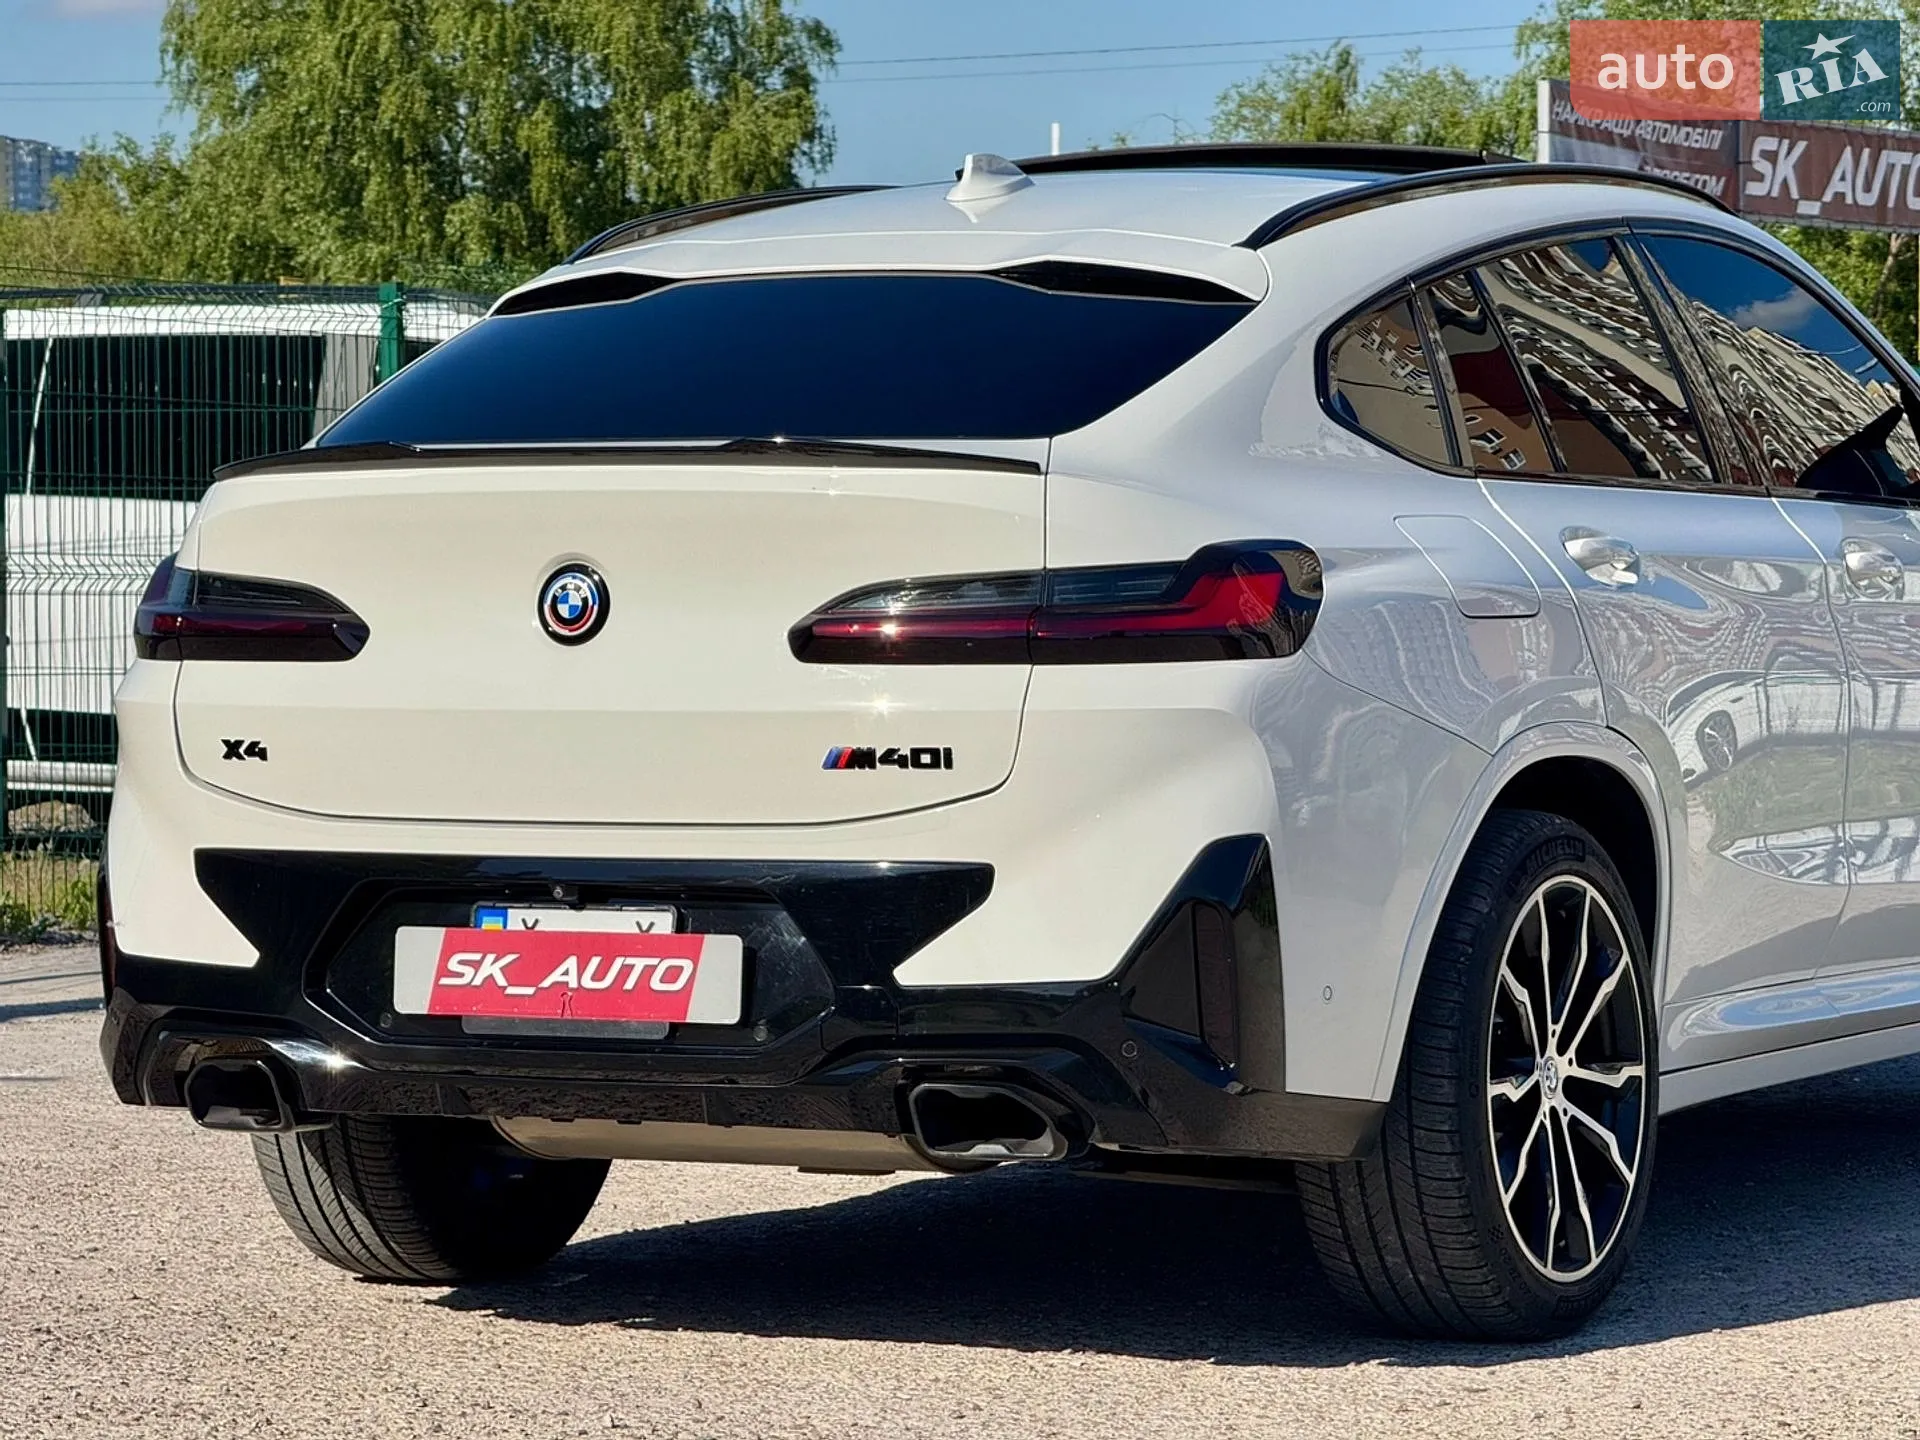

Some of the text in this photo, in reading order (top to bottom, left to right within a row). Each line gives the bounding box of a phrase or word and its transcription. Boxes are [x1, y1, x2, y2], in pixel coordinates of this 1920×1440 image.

[1635, 119, 1723, 150] АВТОМОБІЛІ
[220, 739, 268, 761] X4
[1525, 838, 1584, 876] MICHELIN
[438, 952, 694, 996] SK_AUTO
